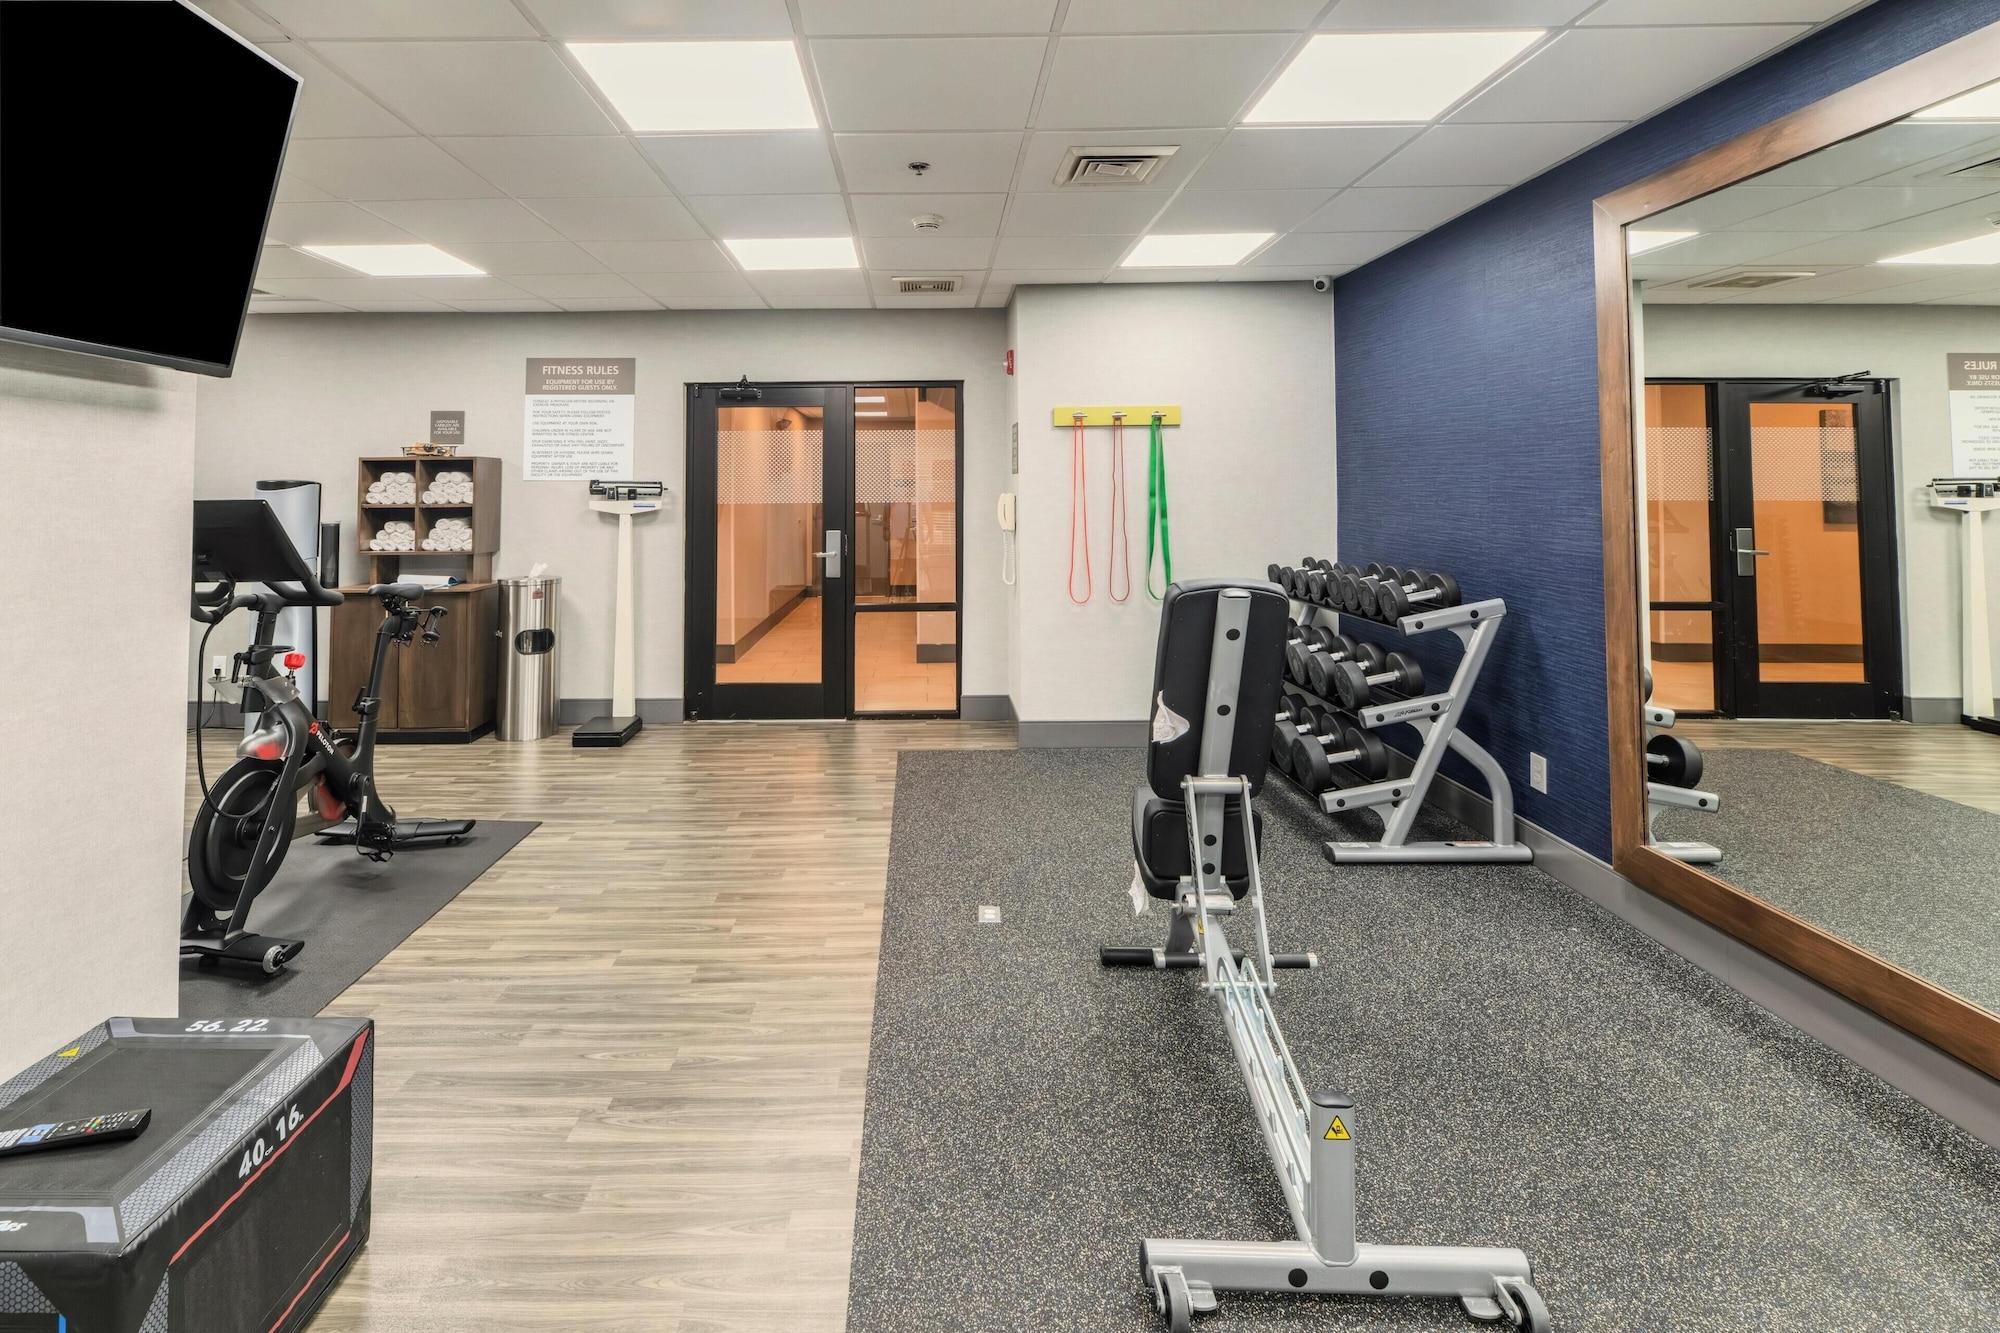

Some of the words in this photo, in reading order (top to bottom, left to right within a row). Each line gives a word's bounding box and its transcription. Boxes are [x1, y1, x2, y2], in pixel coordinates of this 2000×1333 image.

[542, 365, 583, 375] FITNESS
[587, 365, 619, 375] RULES
[316, 730, 335, 755] PELOTON
